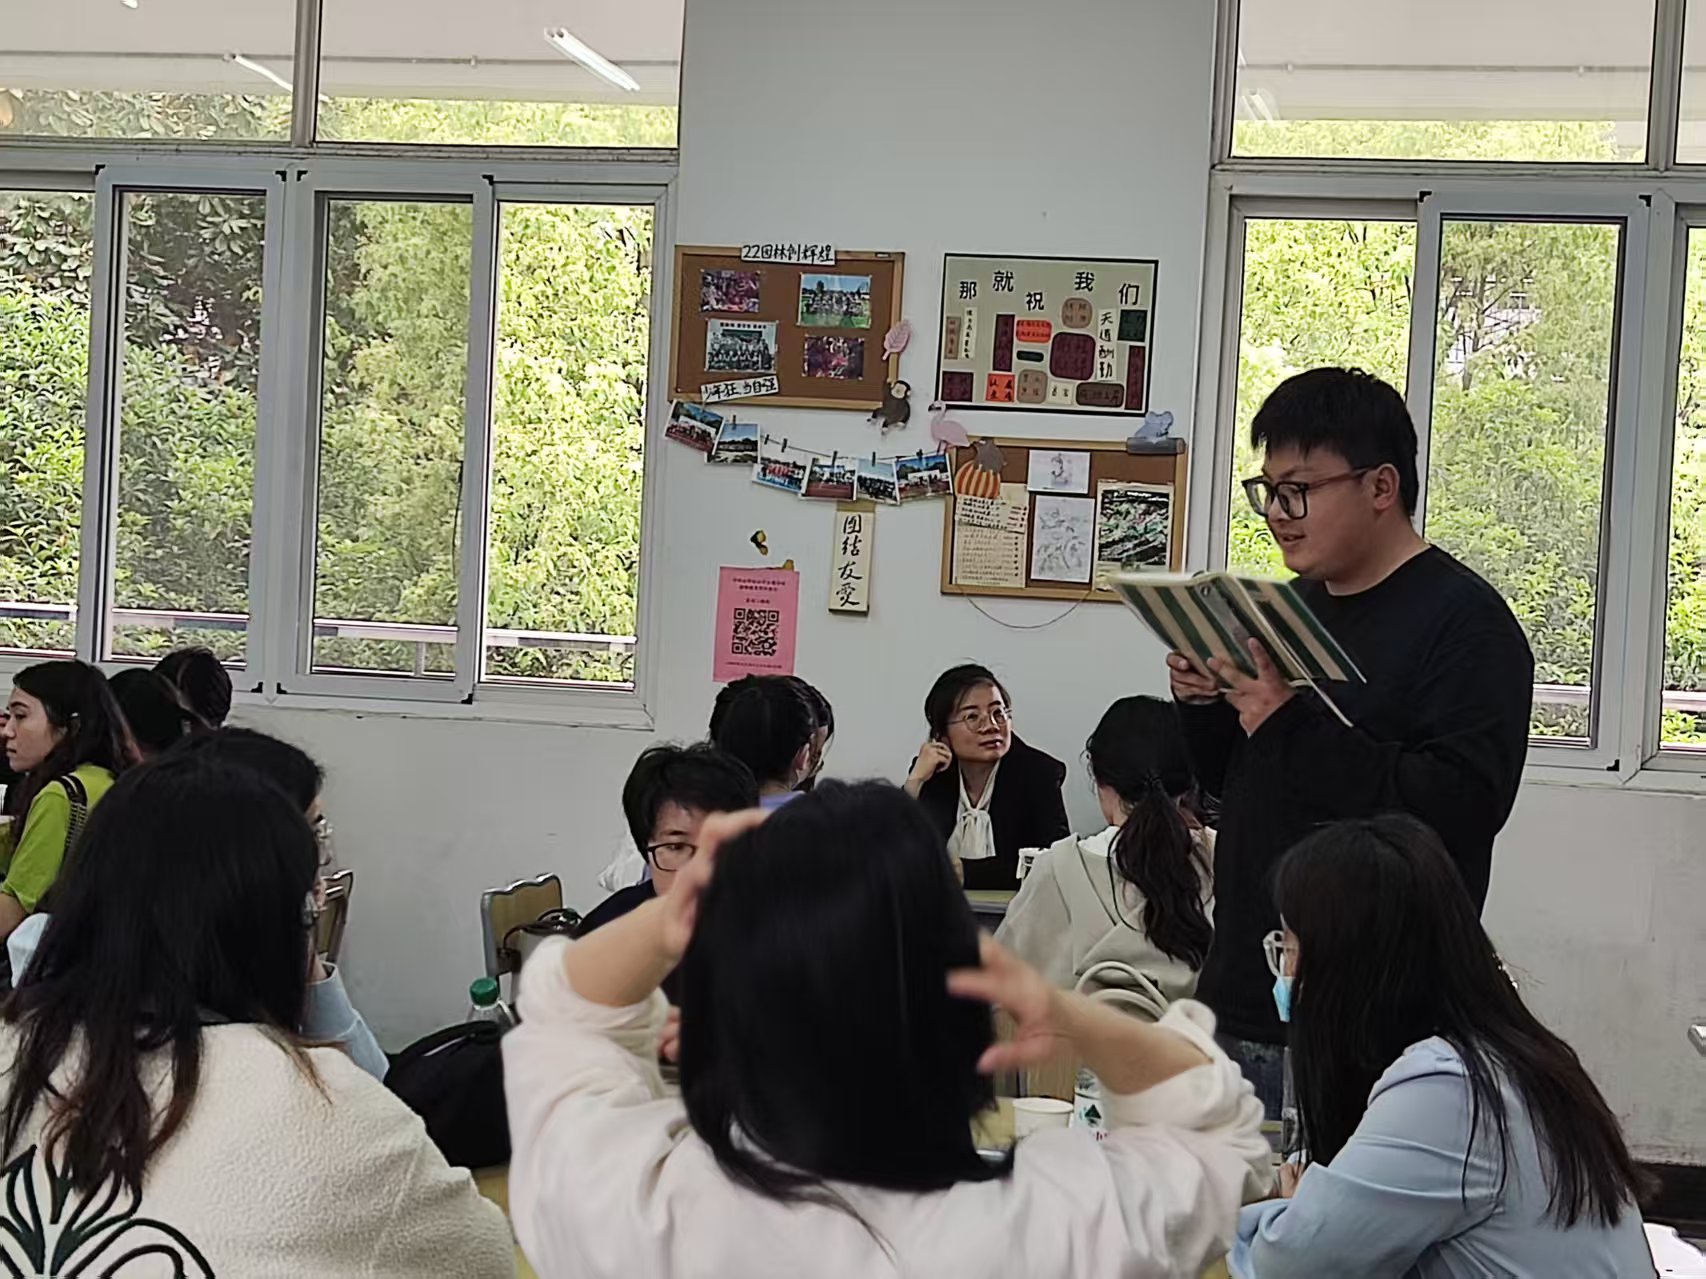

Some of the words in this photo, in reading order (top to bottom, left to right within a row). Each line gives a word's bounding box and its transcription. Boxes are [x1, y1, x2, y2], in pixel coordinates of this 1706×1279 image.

[742, 243, 835, 265] 22园林创辉煌
[1098, 311, 1115, 379] 天道酬勤
